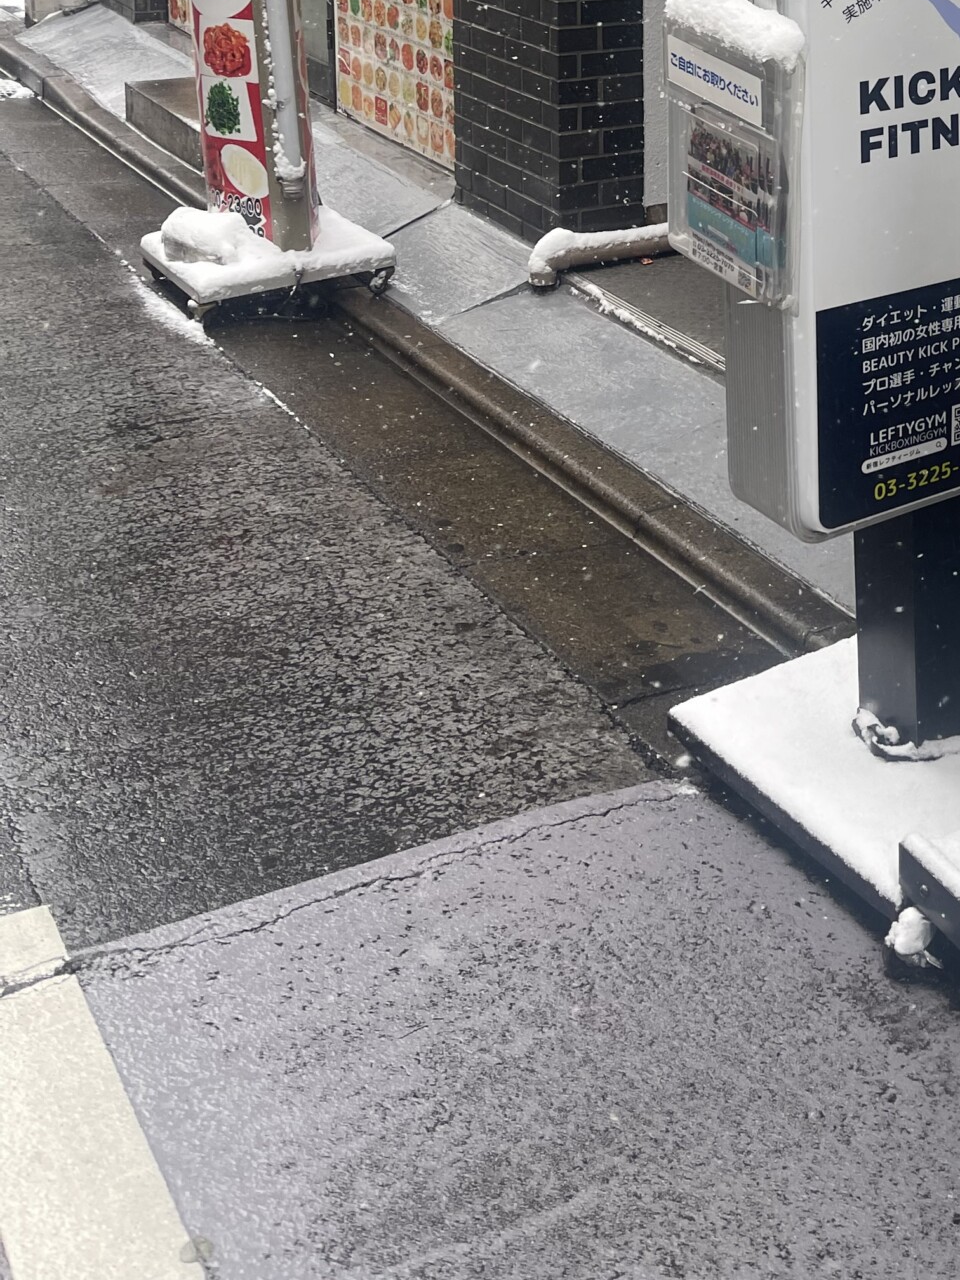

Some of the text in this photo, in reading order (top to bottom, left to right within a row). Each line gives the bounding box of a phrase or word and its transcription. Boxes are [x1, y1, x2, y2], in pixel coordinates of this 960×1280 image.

[670, 52, 759, 107] ご自由にお取りください
[862, 348, 915, 374] BEAUTY
[918, 340, 949, 360] KICK
[868, 425, 947, 458] KICKBOXINGGYM
[869, 410, 947, 446] LEFTYGYM
[865, 448, 921, 470] 新宿レフティージム
